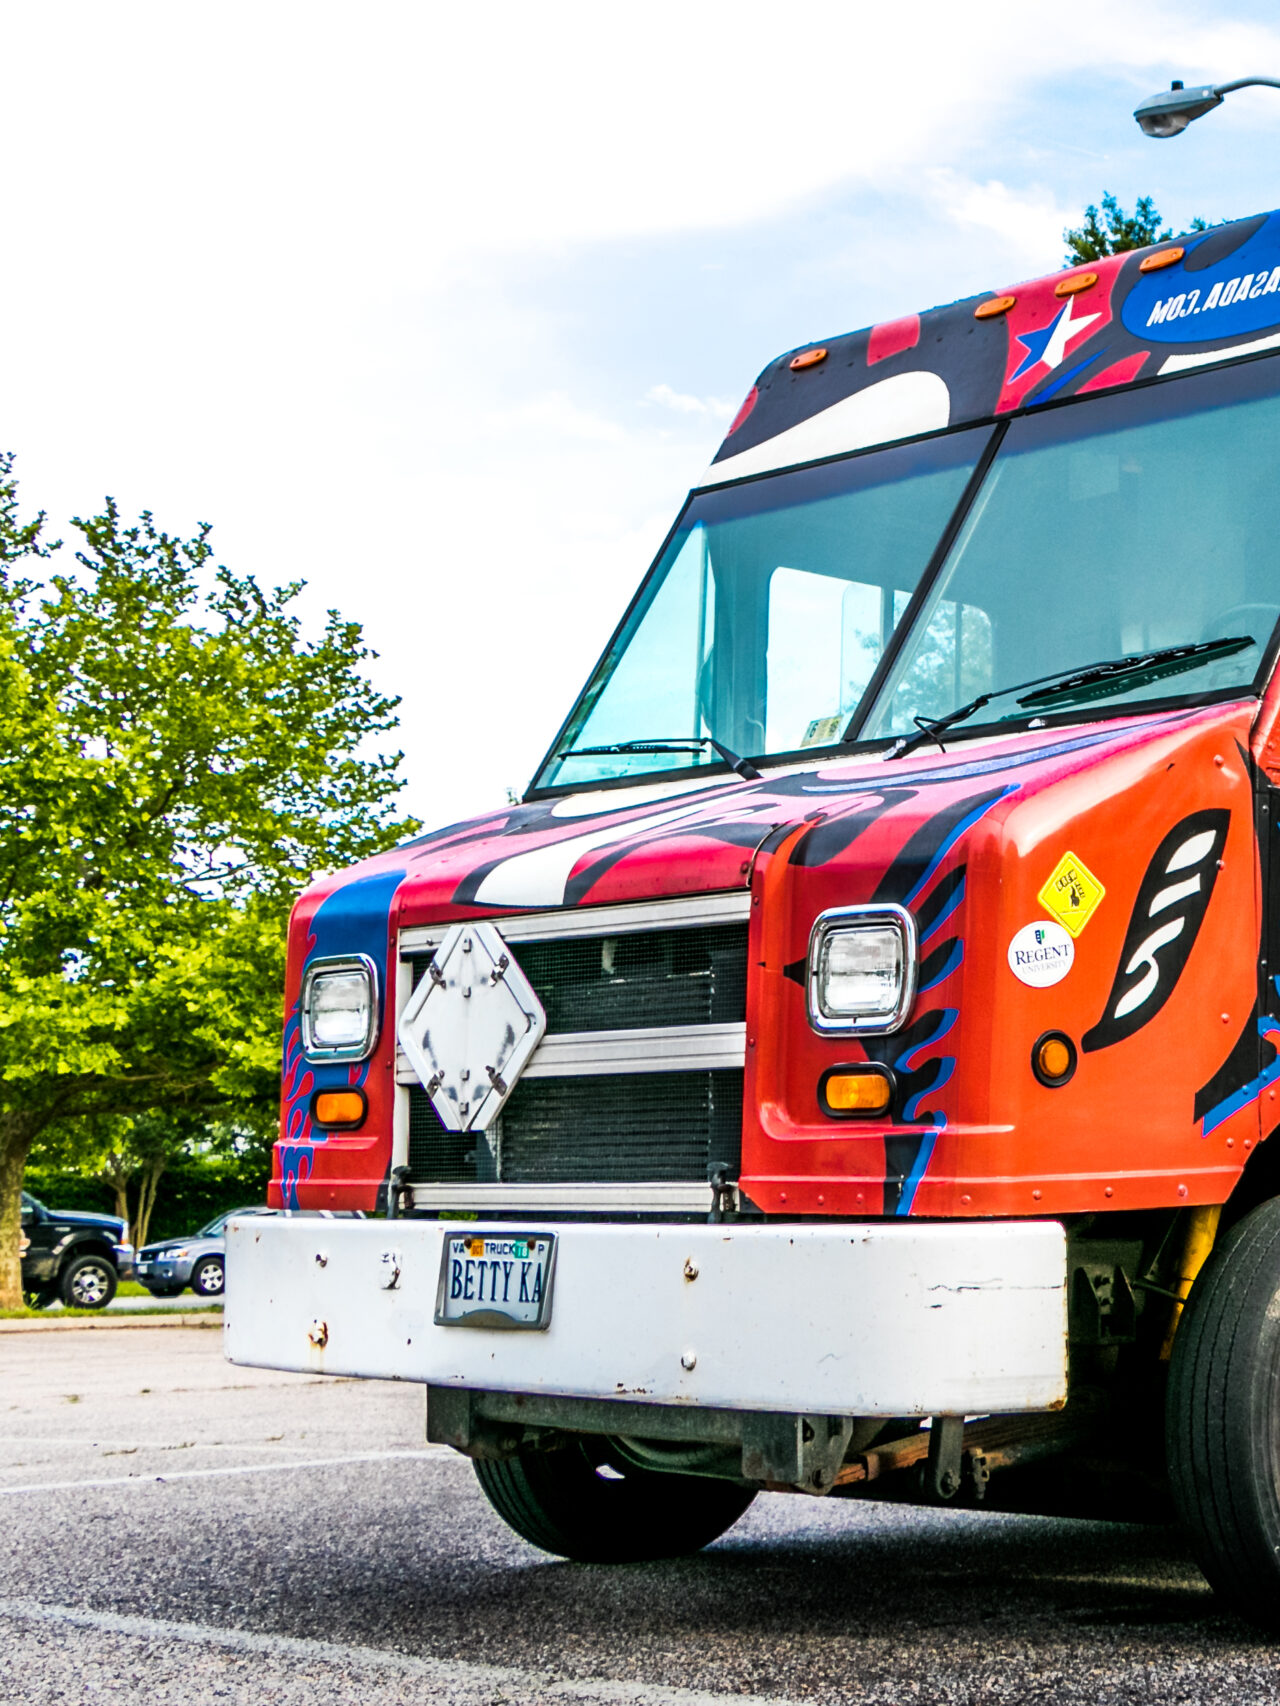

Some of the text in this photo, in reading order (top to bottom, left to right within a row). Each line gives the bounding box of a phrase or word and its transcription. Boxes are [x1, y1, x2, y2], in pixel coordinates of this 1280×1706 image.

[1015, 944, 1070, 965] REGENT
[485, 1243, 515, 1255] TRUCK
[450, 1259, 514, 1302] BETTY
